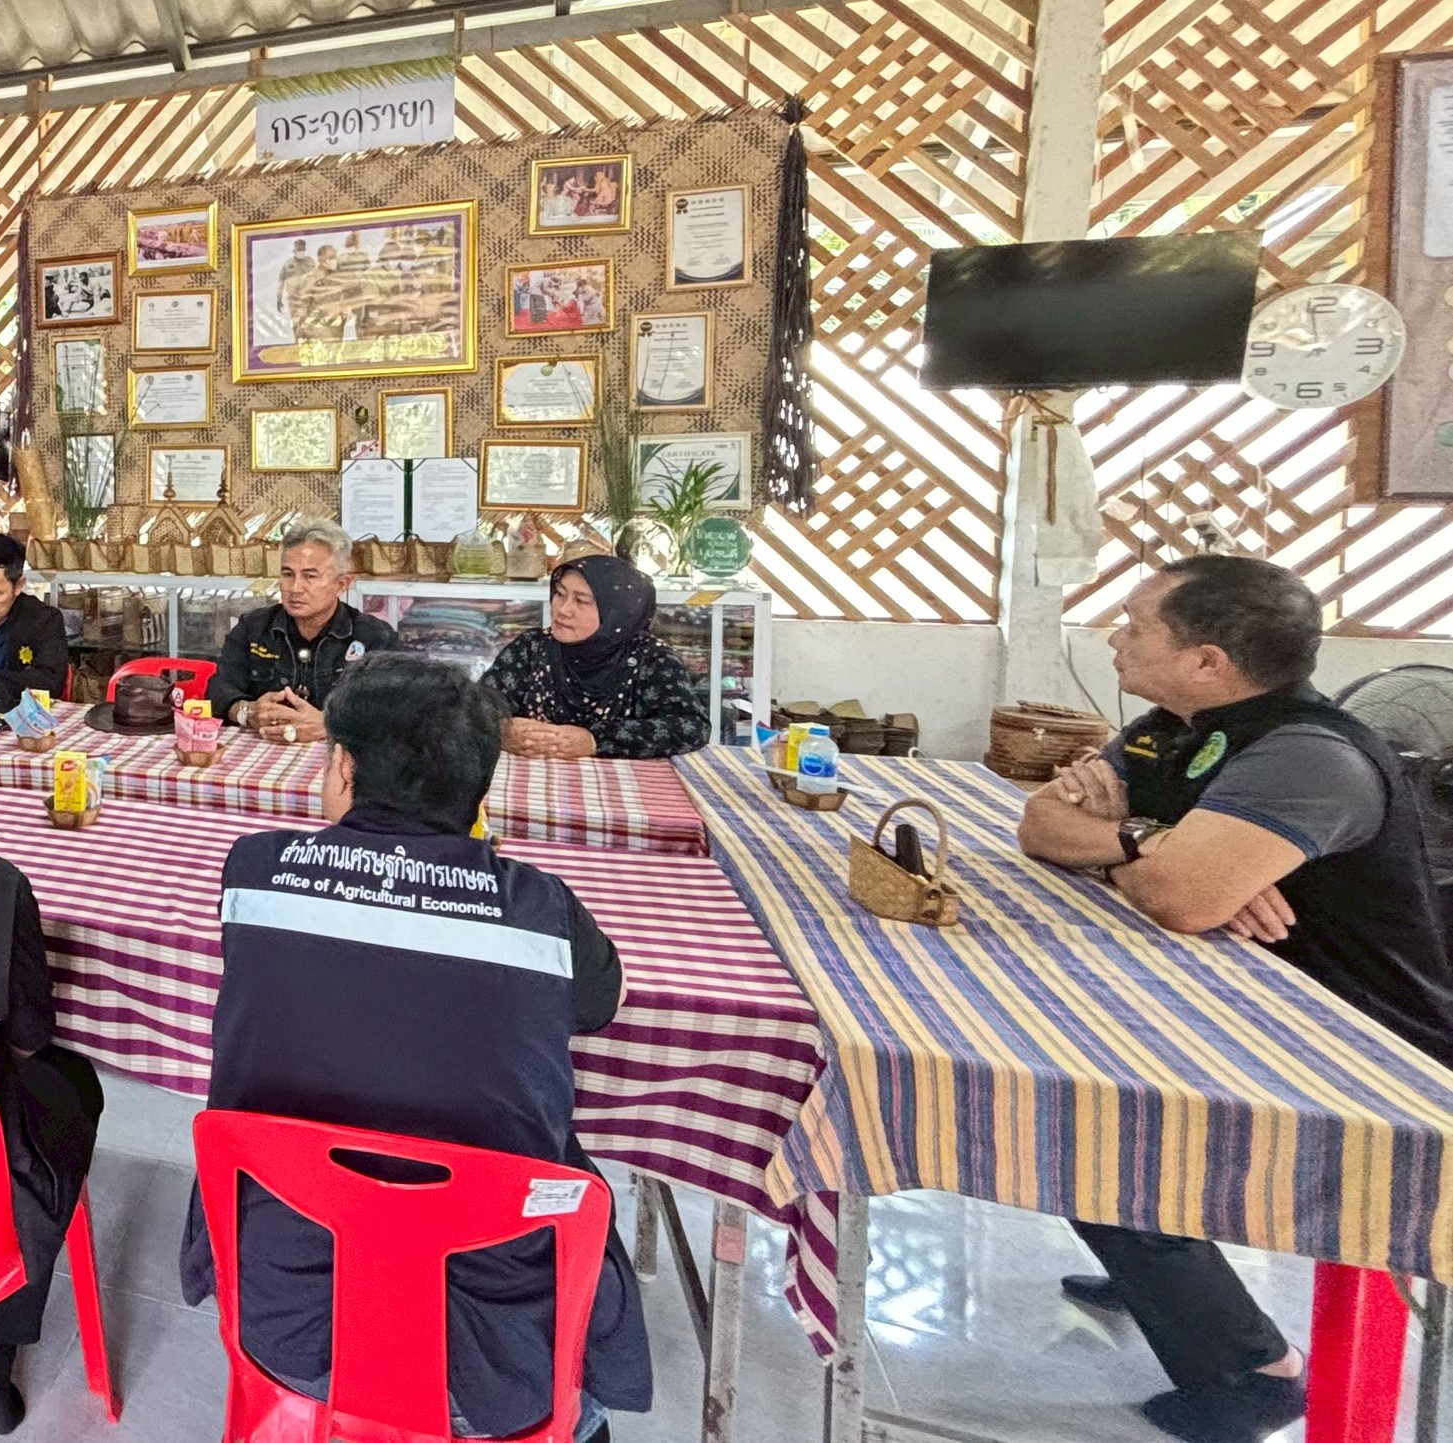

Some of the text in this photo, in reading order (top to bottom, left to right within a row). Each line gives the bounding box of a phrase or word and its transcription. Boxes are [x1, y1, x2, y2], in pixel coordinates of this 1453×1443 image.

[271, 99, 434, 145] กระจูดรายา
[1249, 341, 1276, 357] 9
[1355, 338, 1384, 355] 3
[1254, 367, 1267, 376] 8
[1358, 365, 1371, 373] 4
[1274, 382, 1287, 391] 7
[1296, 381, 1323, 398] 6
[1333, 382, 1346, 391] 5
[280, 836, 498, 893] สำนักงานเศรษฐกิจการเกษตร
[272, 872, 503, 918] office of Agricultural Economics
